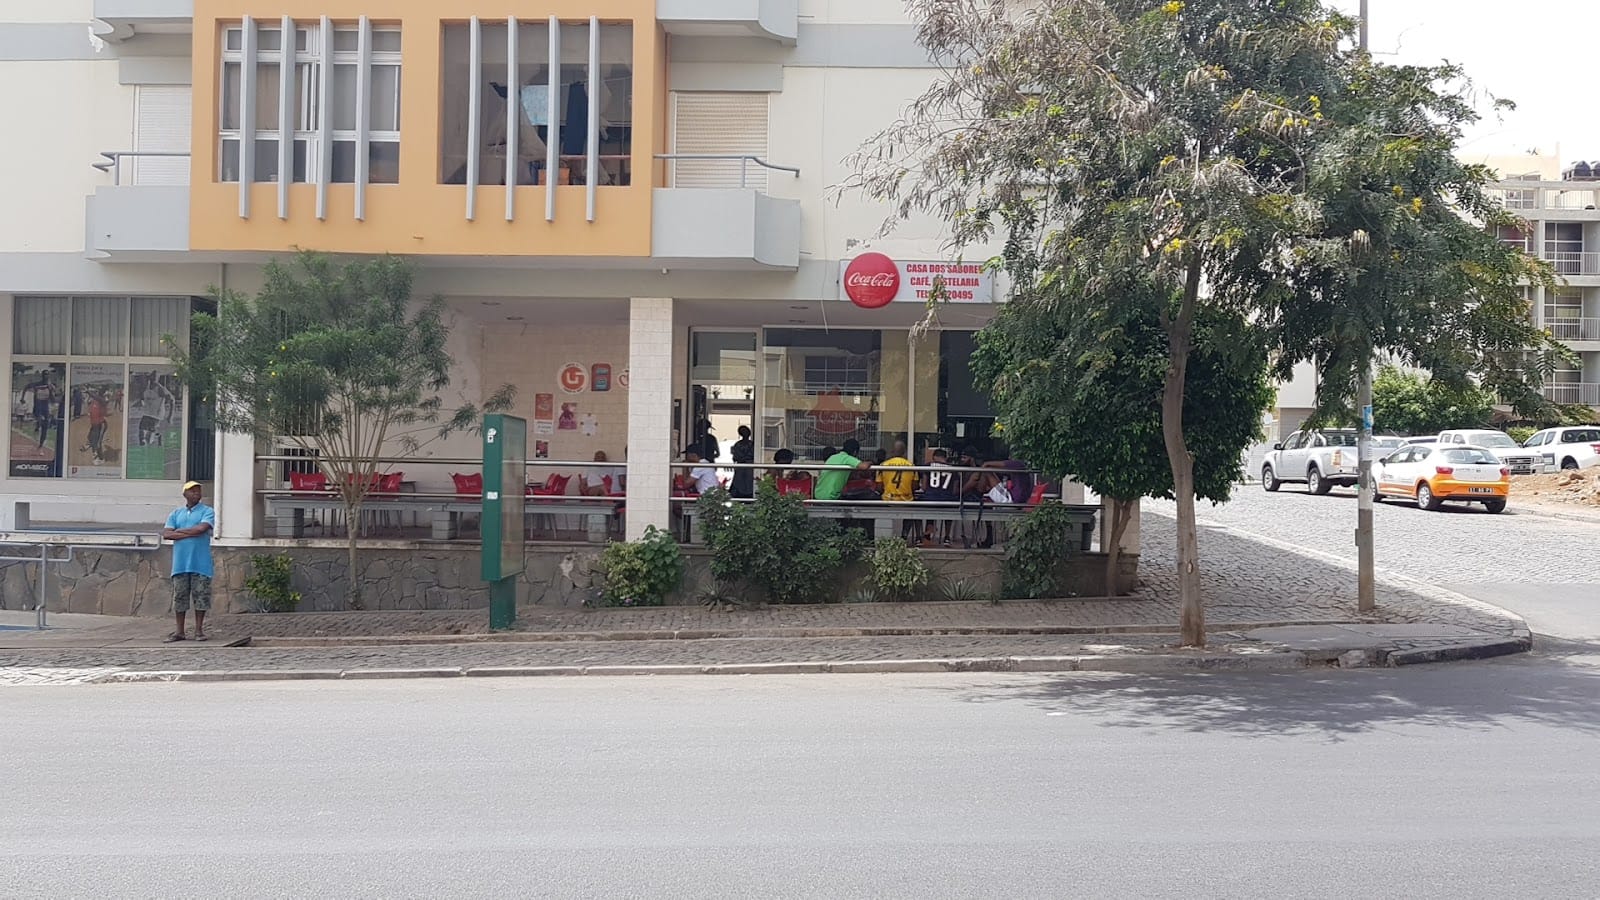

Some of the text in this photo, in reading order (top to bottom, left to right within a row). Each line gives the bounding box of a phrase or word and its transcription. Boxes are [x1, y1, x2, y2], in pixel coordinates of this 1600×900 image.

[906, 264, 928, 273] CASA
[929, 264, 945, 274] DOS
[848, 272, 896, 287] Coca-Cola
[933, 277, 979, 287] ASTELARIA
[892, 470, 902, 489] 4
[930, 470, 952, 489] 87
